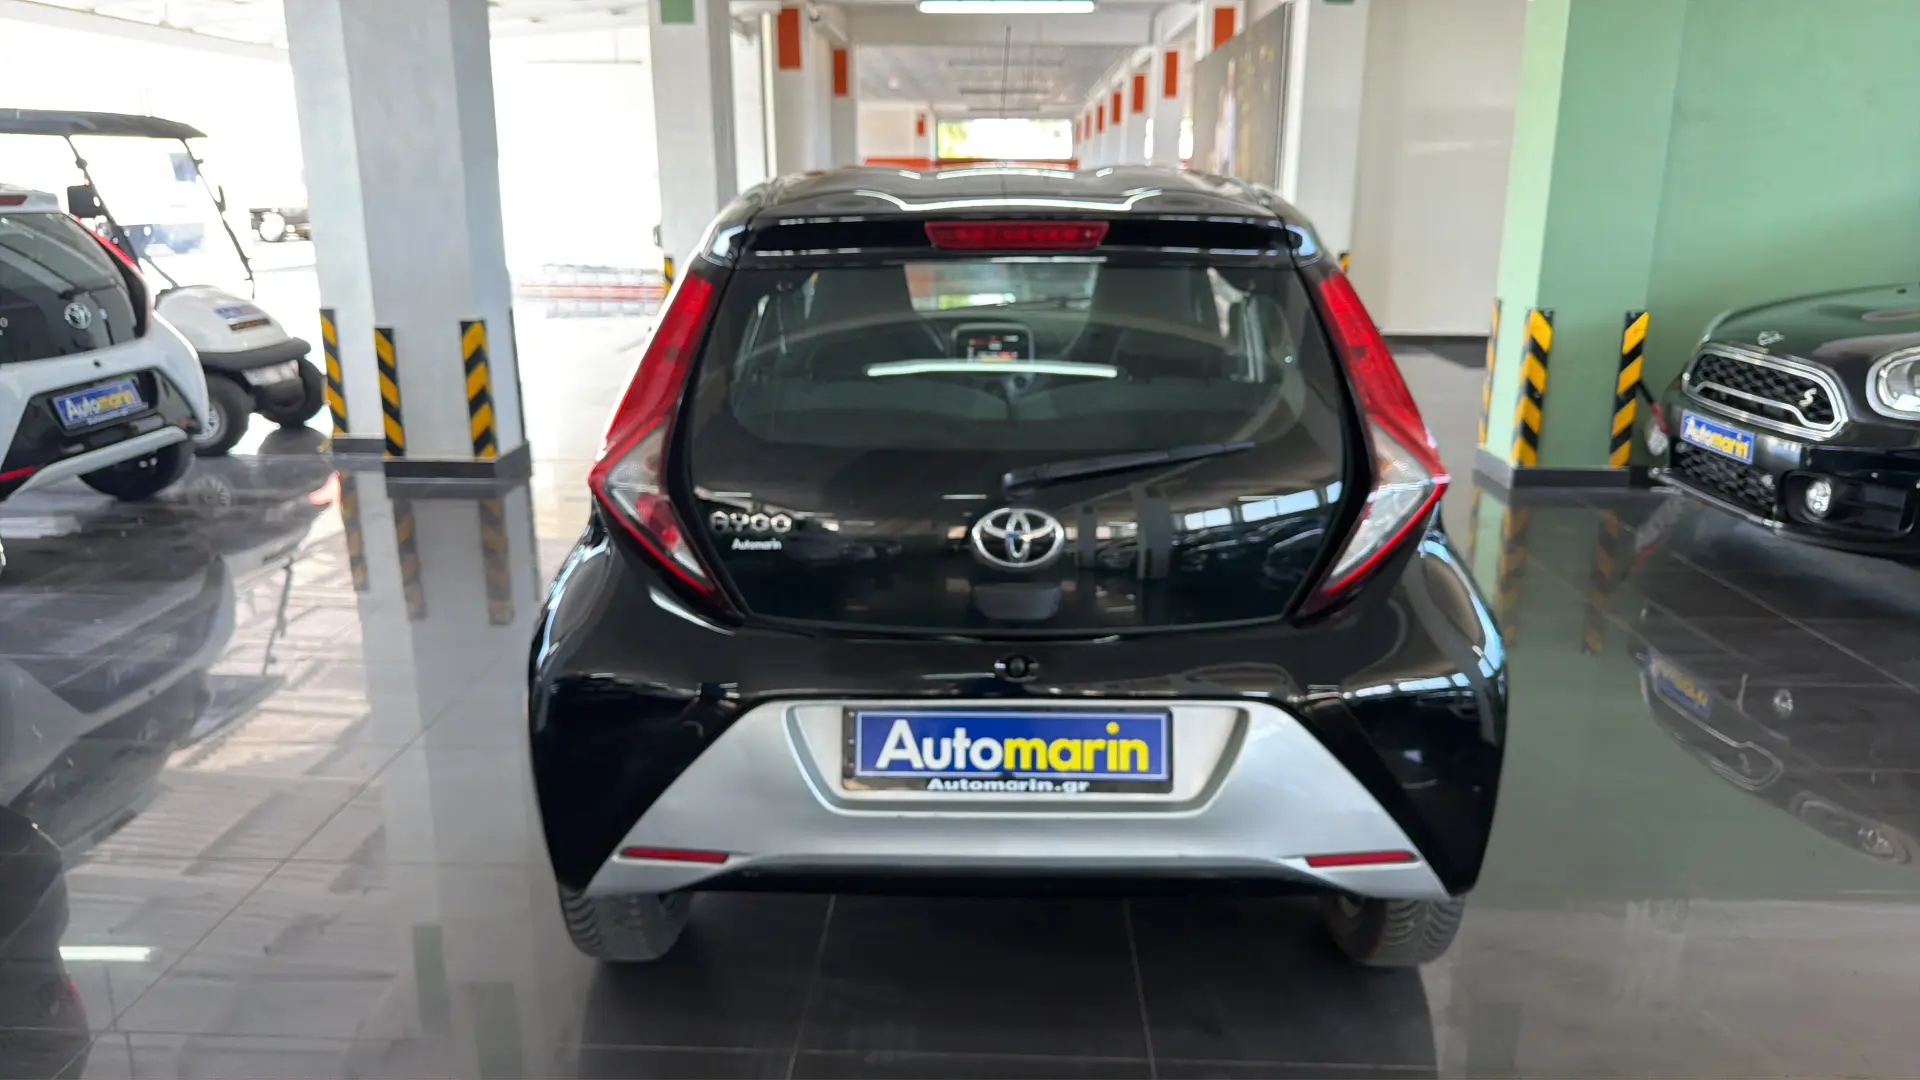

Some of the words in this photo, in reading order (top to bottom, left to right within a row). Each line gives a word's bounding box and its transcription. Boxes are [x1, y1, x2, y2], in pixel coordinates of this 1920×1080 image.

[709, 510, 792, 533] AYGO
[731, 537, 782, 551] Automarin
[875, 718, 1149, 773] Automarin
[925, 776, 1090, 793] Automarin.gr
